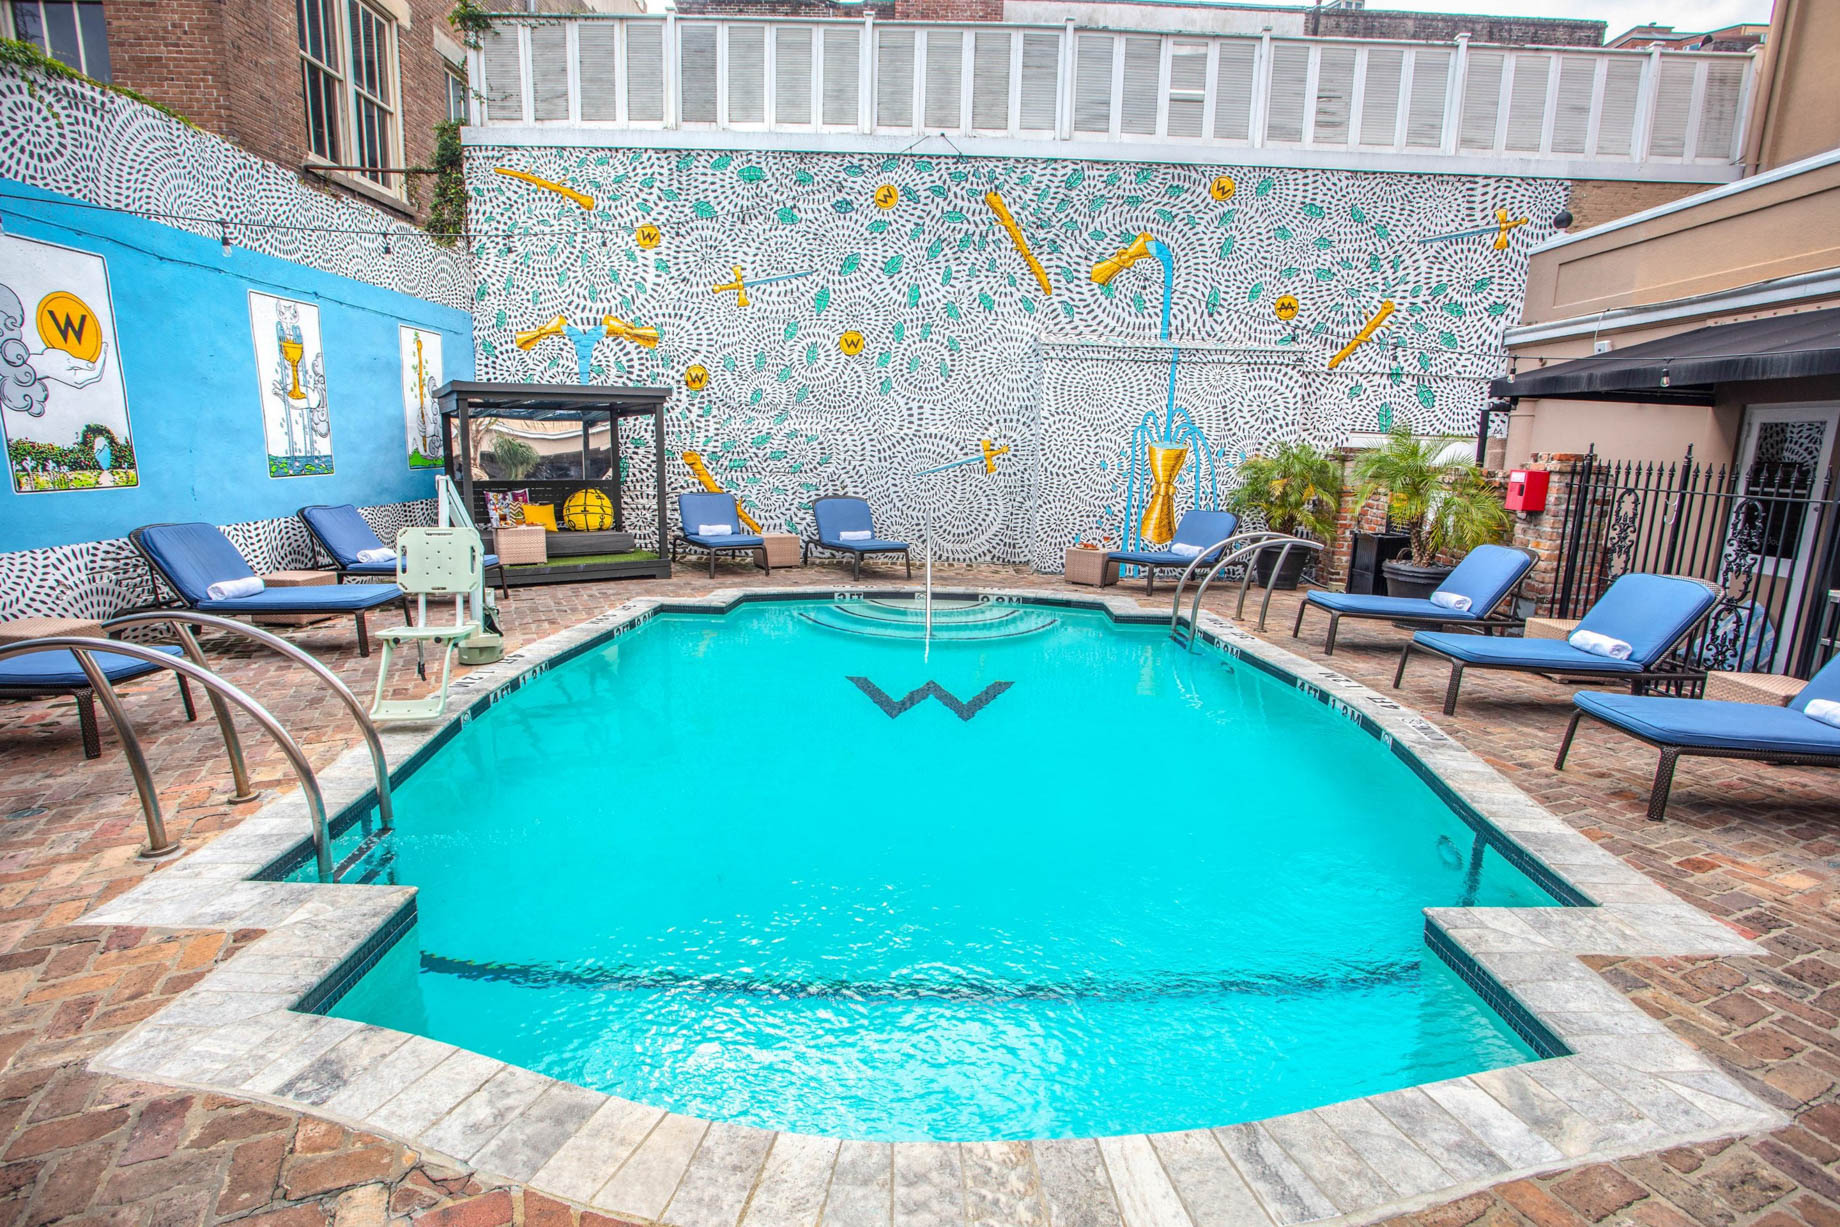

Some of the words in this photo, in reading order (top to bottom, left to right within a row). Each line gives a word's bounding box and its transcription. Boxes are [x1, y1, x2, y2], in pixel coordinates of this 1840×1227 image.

[878, 187, 893, 203] W
[1216, 180, 1231, 196] W
[641, 229, 657, 242] W
[46, 309, 87, 346] W
[844, 338, 860, 349] W
[689, 372, 704, 384] W
[845, 675, 1015, 722] W
